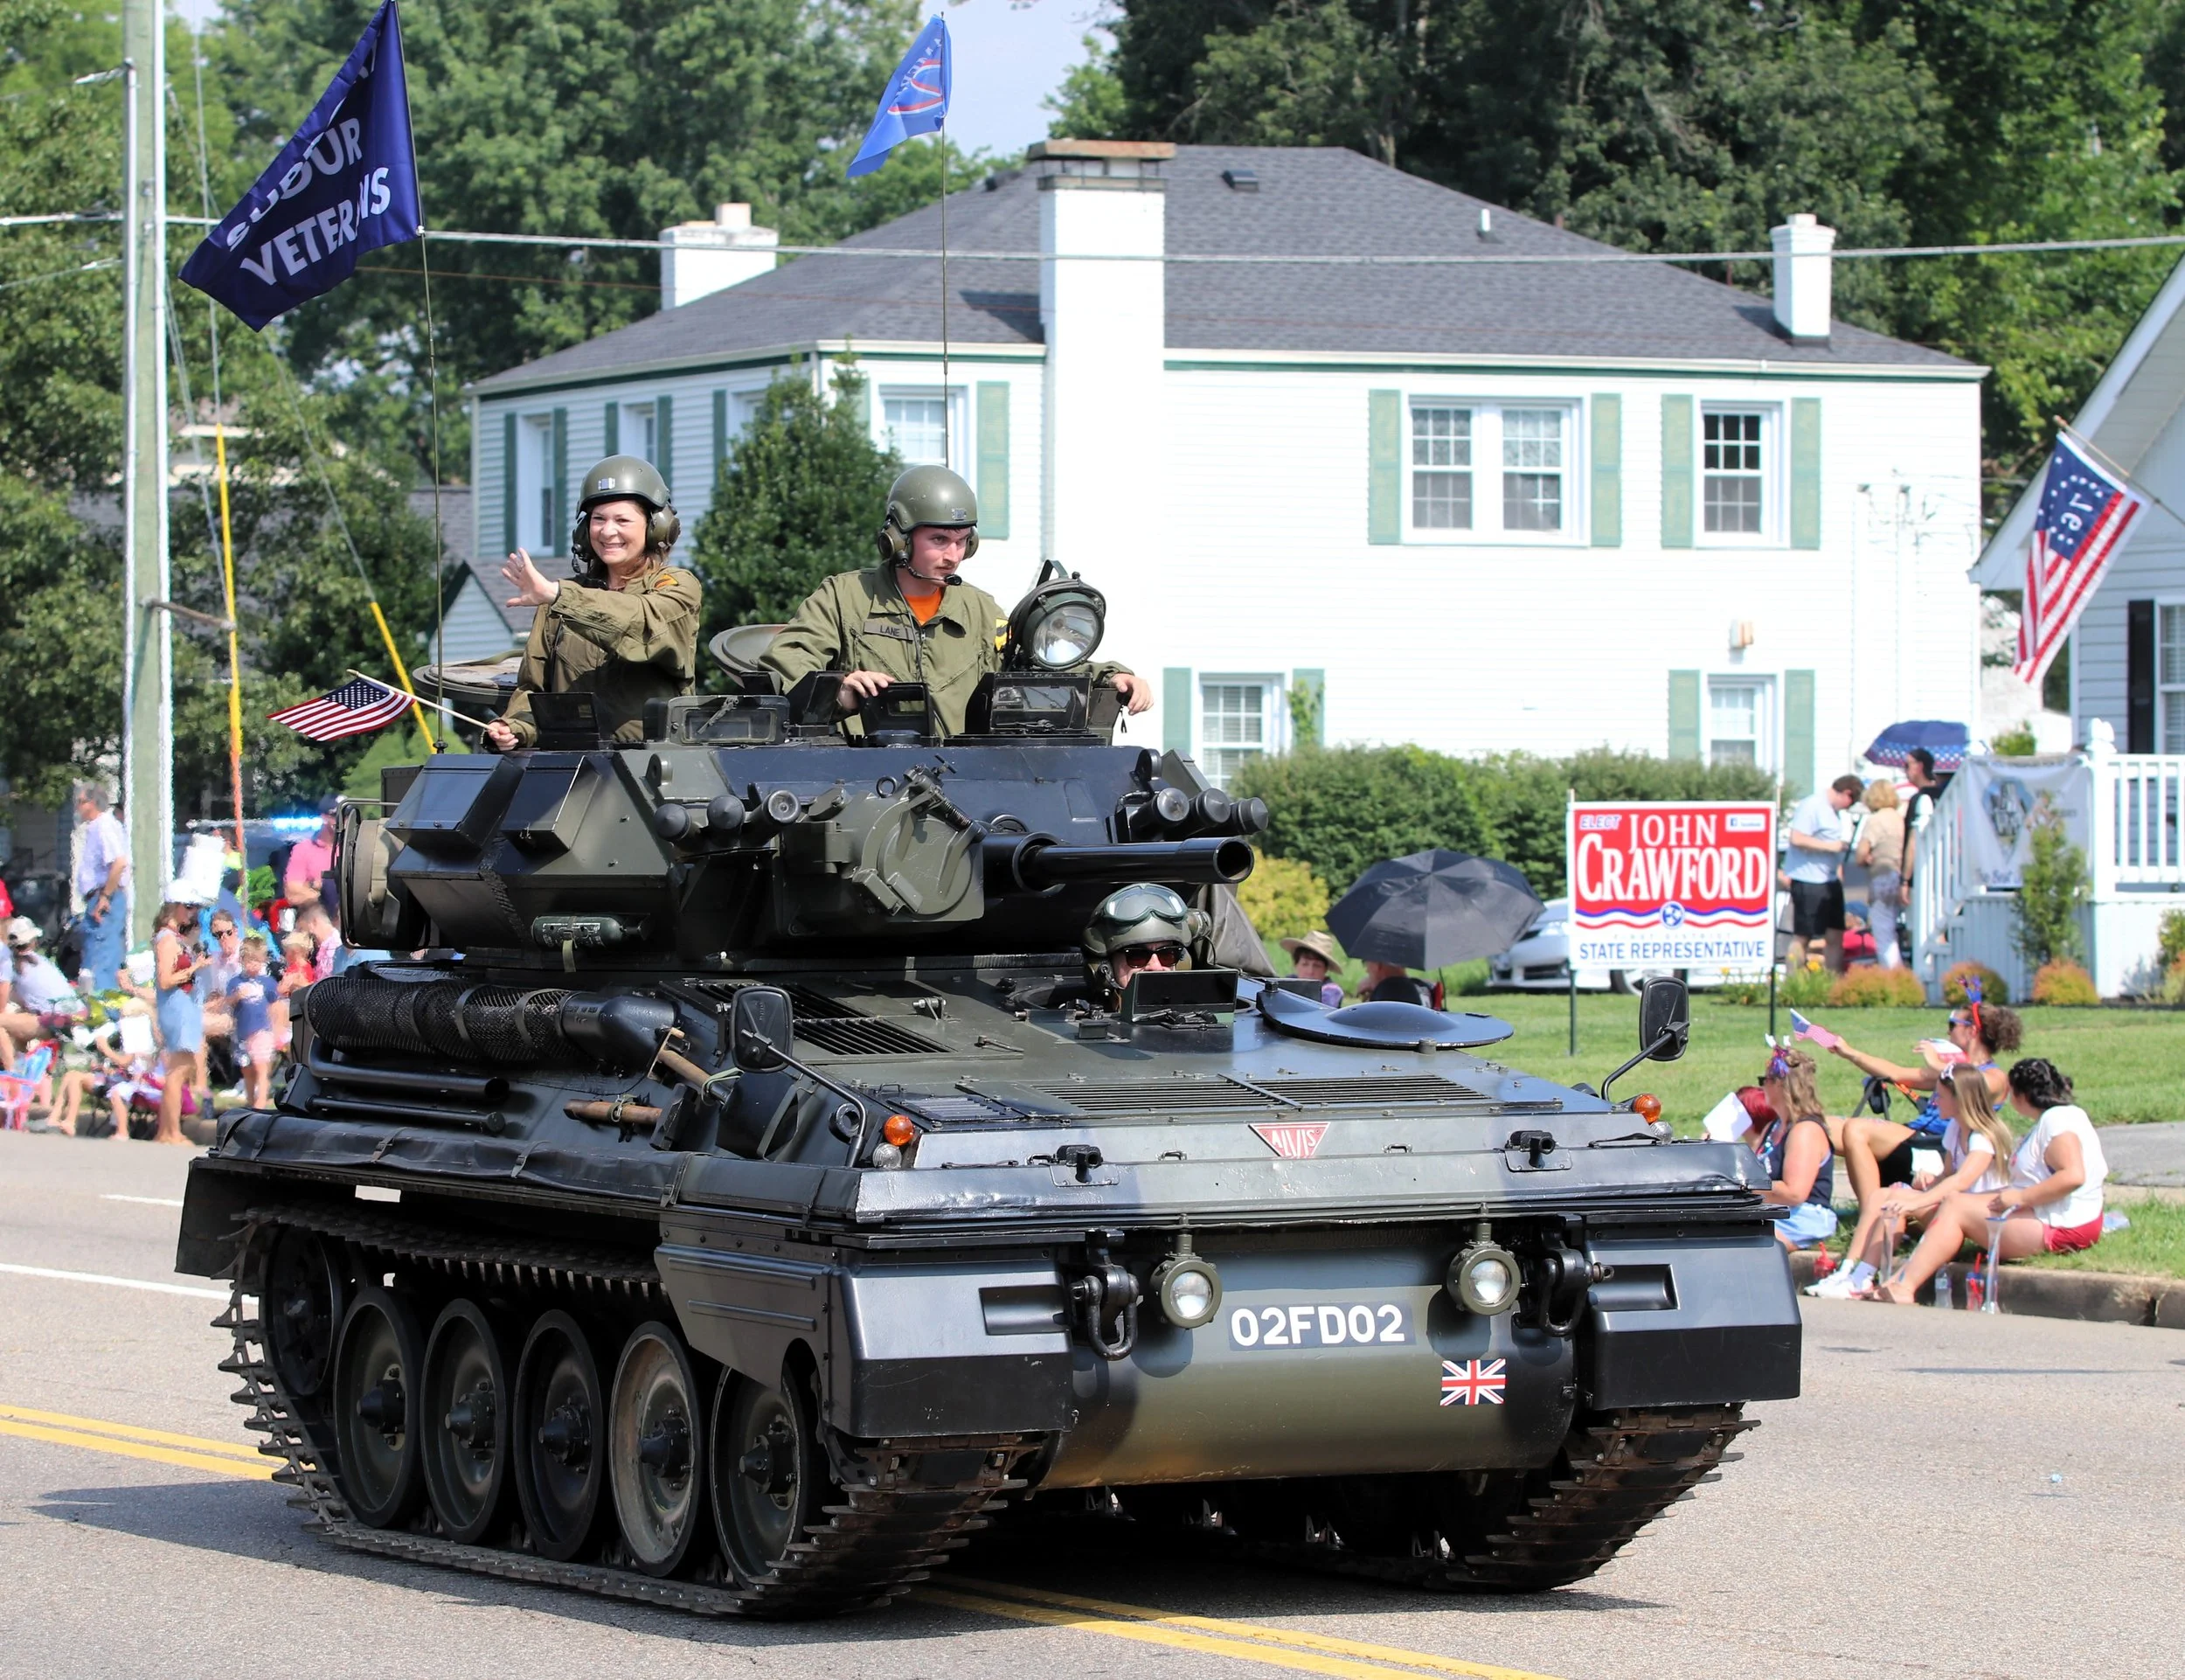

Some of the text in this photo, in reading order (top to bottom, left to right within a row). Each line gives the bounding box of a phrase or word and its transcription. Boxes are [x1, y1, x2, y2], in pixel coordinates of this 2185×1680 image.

[880, 625, 900, 636] LANE
[1580, 816, 1620, 829] ELECT
[1629, 814, 1717, 854] JOHN
[1577, 833, 1768, 901] CRAWFORD
[1579, 941, 1765, 960] STATE REPRESENTATIVE
[1272, 1128, 1317, 1157] ALVIS
